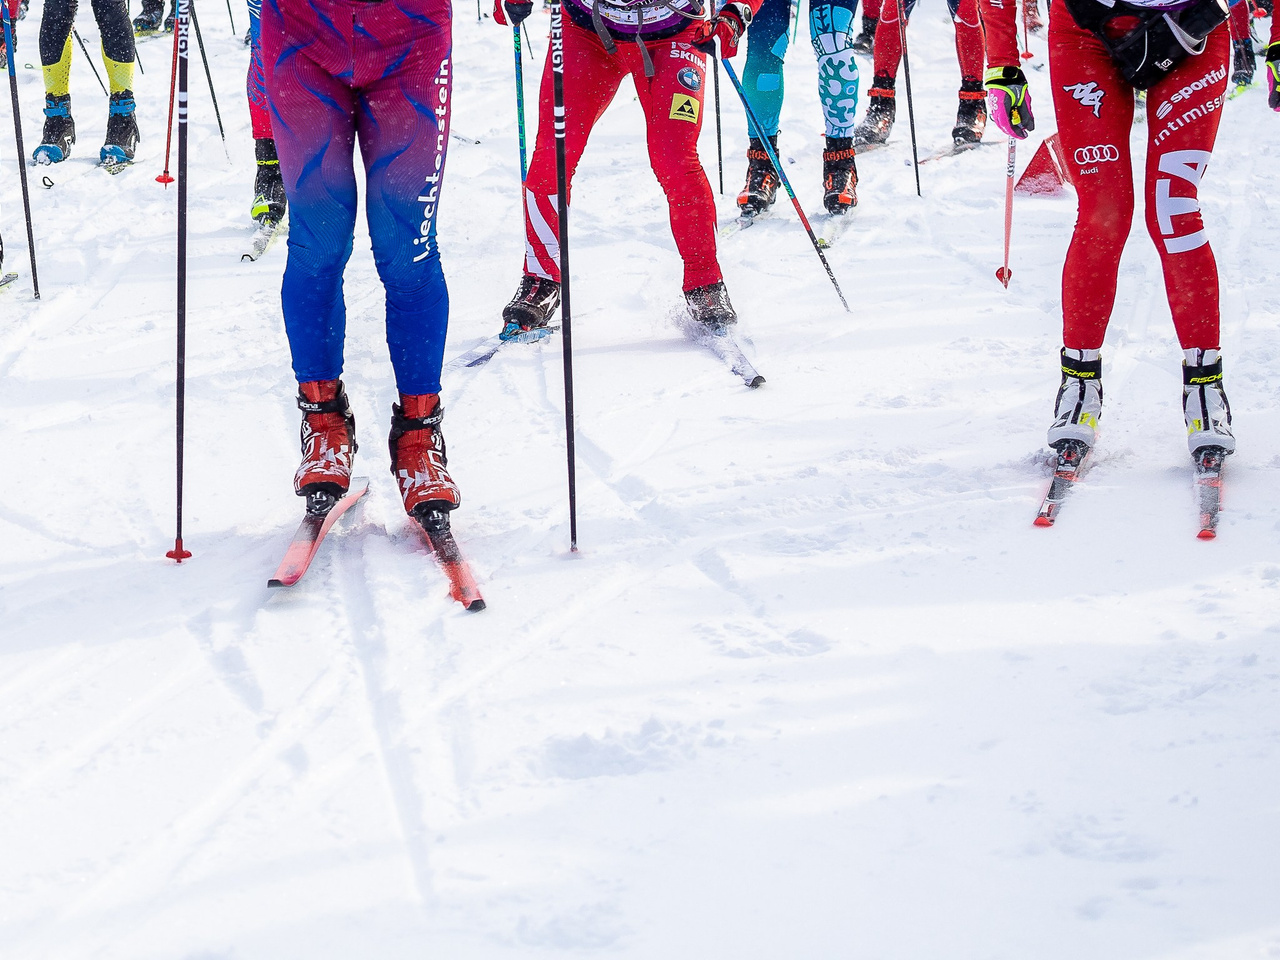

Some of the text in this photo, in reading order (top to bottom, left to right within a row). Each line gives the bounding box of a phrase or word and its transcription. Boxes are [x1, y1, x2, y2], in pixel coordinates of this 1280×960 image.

[550, 3, 564, 75] ENERGY
[1171, 64, 1227, 104] sportful
[1080, 167, 1098, 175] Audi
[1155, 149, 1212, 254] ITA
